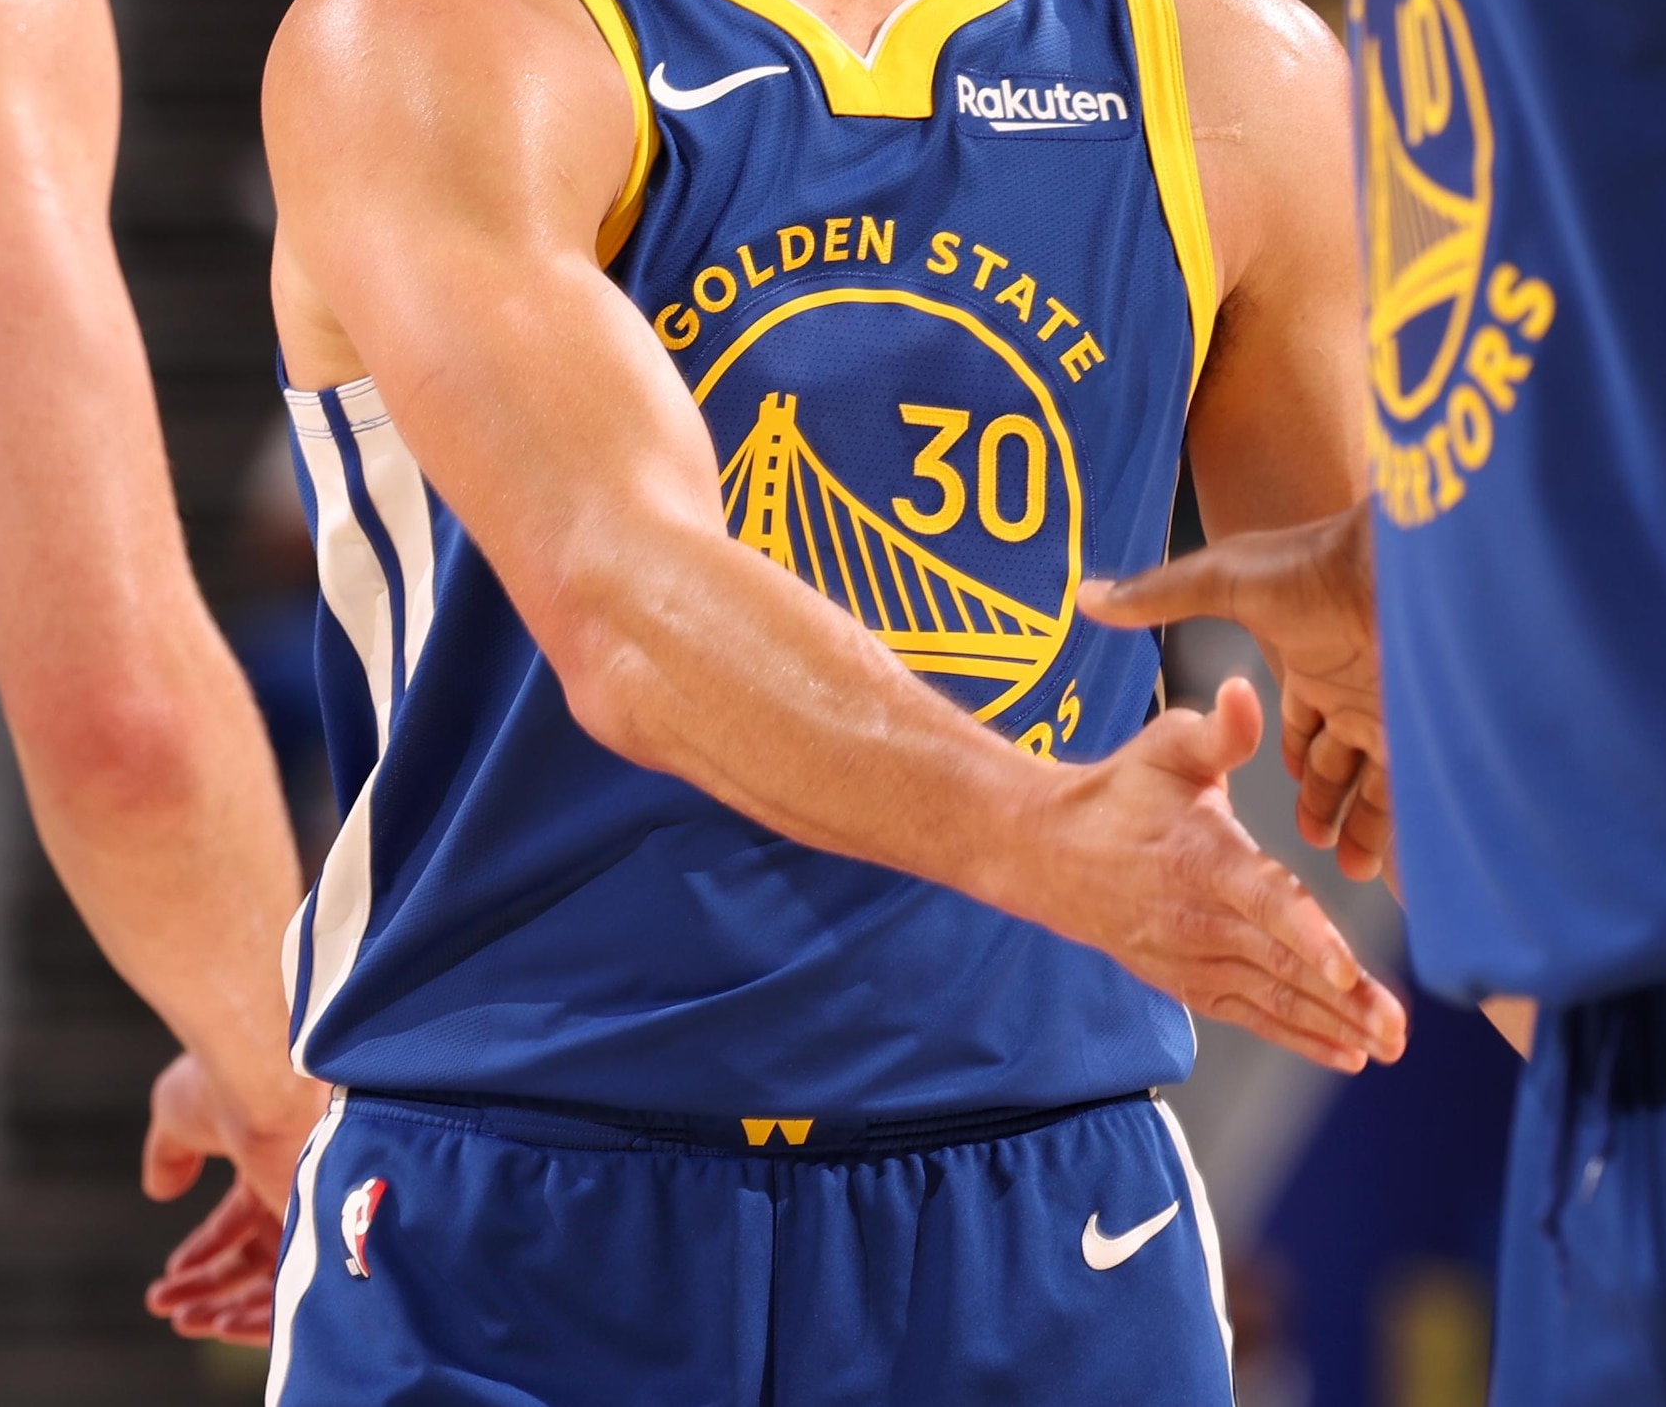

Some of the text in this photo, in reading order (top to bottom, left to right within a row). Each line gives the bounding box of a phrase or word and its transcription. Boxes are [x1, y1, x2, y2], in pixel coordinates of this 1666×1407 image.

[956, 74, 1129, 122] Rakuten
[653, 215, 1106, 382] GOLDEN STATE
[890, 403, 1048, 544] 30
